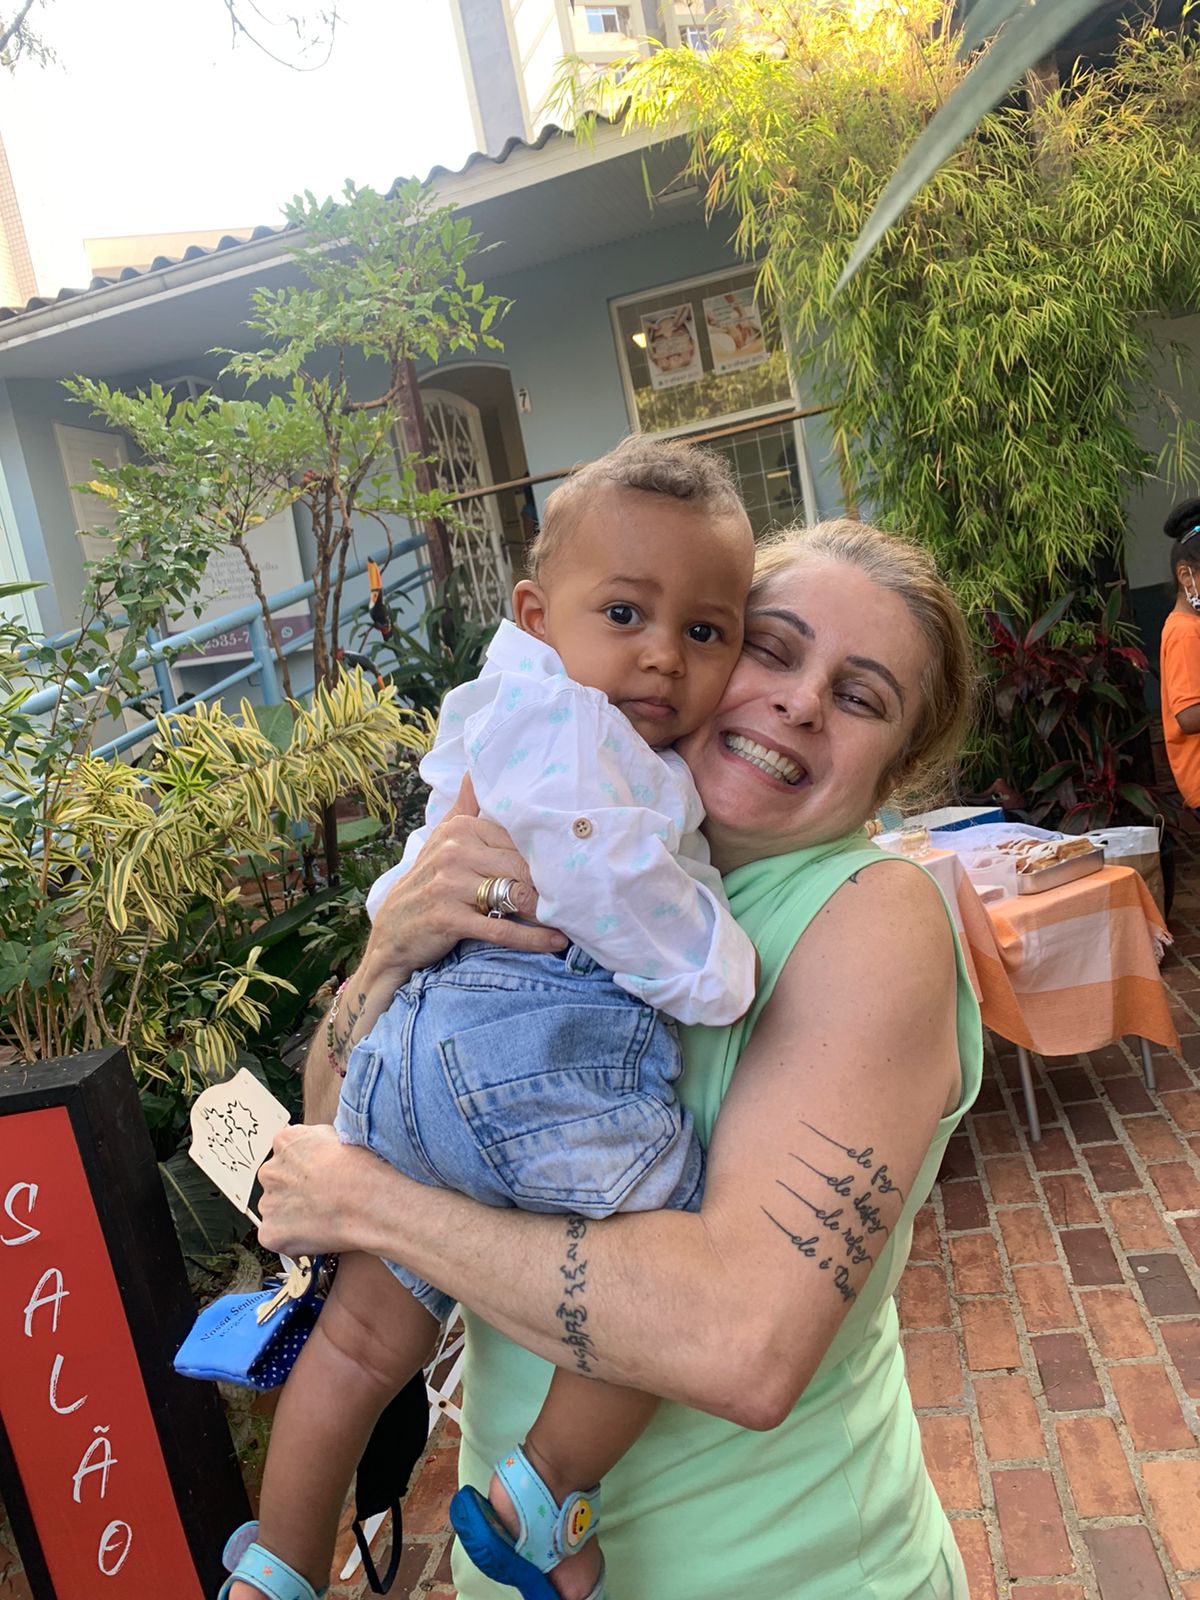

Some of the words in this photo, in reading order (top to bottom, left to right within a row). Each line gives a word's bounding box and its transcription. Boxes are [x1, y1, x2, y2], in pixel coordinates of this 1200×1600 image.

[518, 392, 527, 409] 7
[200, 1315, 231, 1343] Nossa
[1, 1182, 133, 1576] SALÃO
